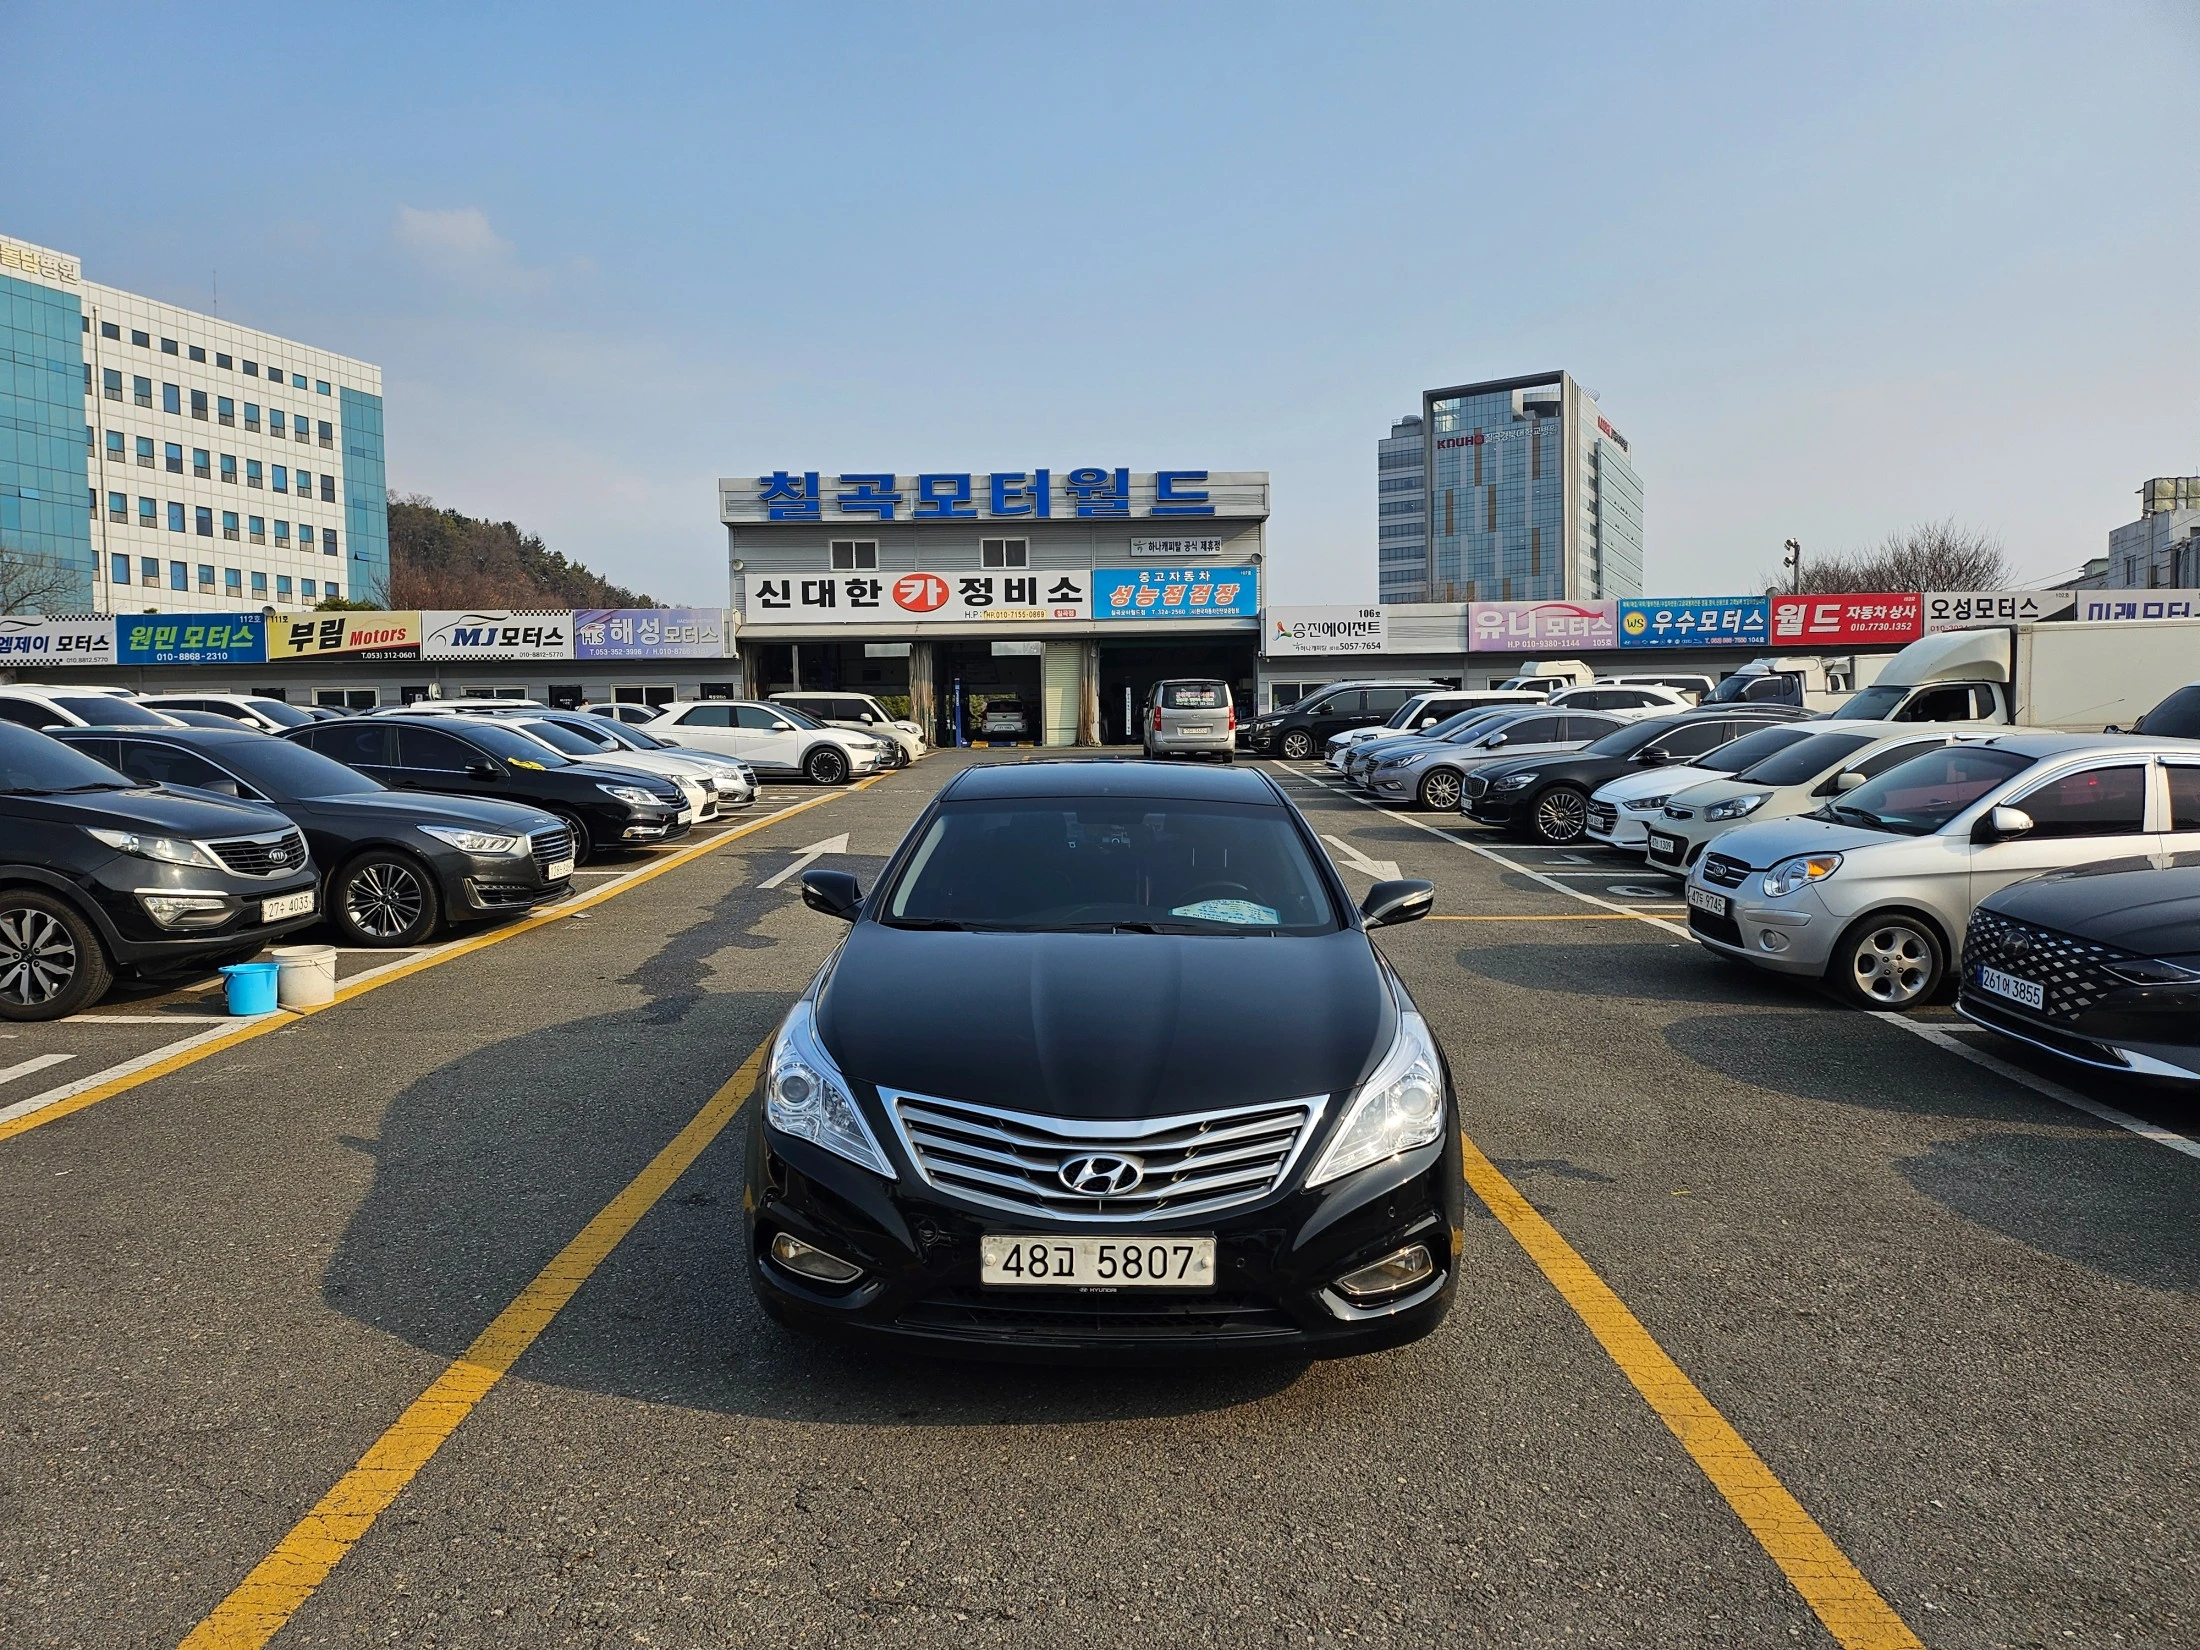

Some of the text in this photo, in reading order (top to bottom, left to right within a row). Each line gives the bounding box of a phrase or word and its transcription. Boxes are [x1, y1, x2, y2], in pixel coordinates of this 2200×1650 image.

[758, 468, 1216, 521] 칠곡모터월드
[1148, 540, 1221, 552] 하나캐피탈 공식 제휴점
[1139, 571, 1211, 582] 중고자동차
[755, 576, 1084, 609] 신대한 카 정비소
[1109, 584, 1240, 606] 성능점검장
[1359, 610, 1381, 618] 106호
[1931, 598, 2038, 620] 오성모터스
[1475, 611, 1612, 639] 유니 모터스
[1627, 618, 1644, 628] WS
[1652, 609, 1764, 635] 우수모터스
[1775, 604, 1842, 636] 월드
[1850, 622, 1912, 631] 010.7730.1352
[128, 625, 254, 650] 원민 모터스
[288, 618, 407, 652] 부림 Motors
[1292, 622, 1381, 638] 승진에이전트
[0, 635, 109, 653] 엠제이 모터스
[156, 652, 228, 661] 010-8868-2310
[384, 651, 416, 659] 312-0601
[273, 852, 284, 860] KIA
[289, 896, 308, 912] 4033
[1706, 895, 1721, 912] 9745
[2012, 978, 2041, 1005] 3855
[1002, 1244, 1194, 1279] 48고 5807
